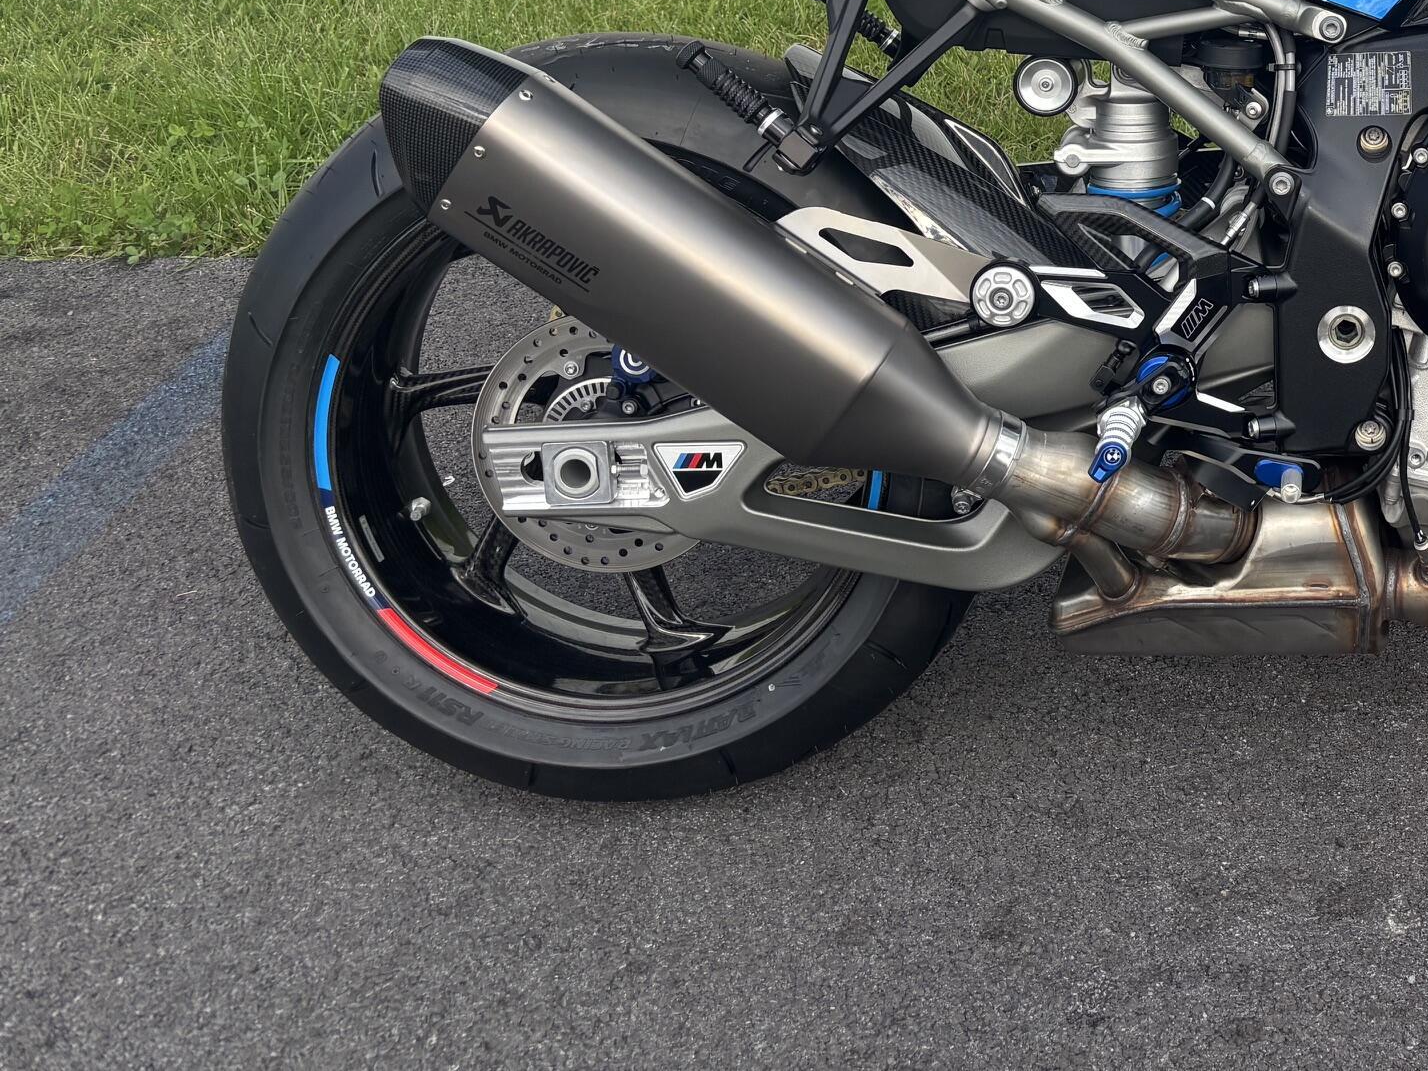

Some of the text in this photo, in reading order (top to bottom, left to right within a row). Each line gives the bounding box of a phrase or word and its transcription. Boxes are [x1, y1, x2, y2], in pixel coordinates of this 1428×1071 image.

[483, 231, 562, 284] BMW MOTORRAD
[325, 505, 376, 598] BMW MOTORRAD
